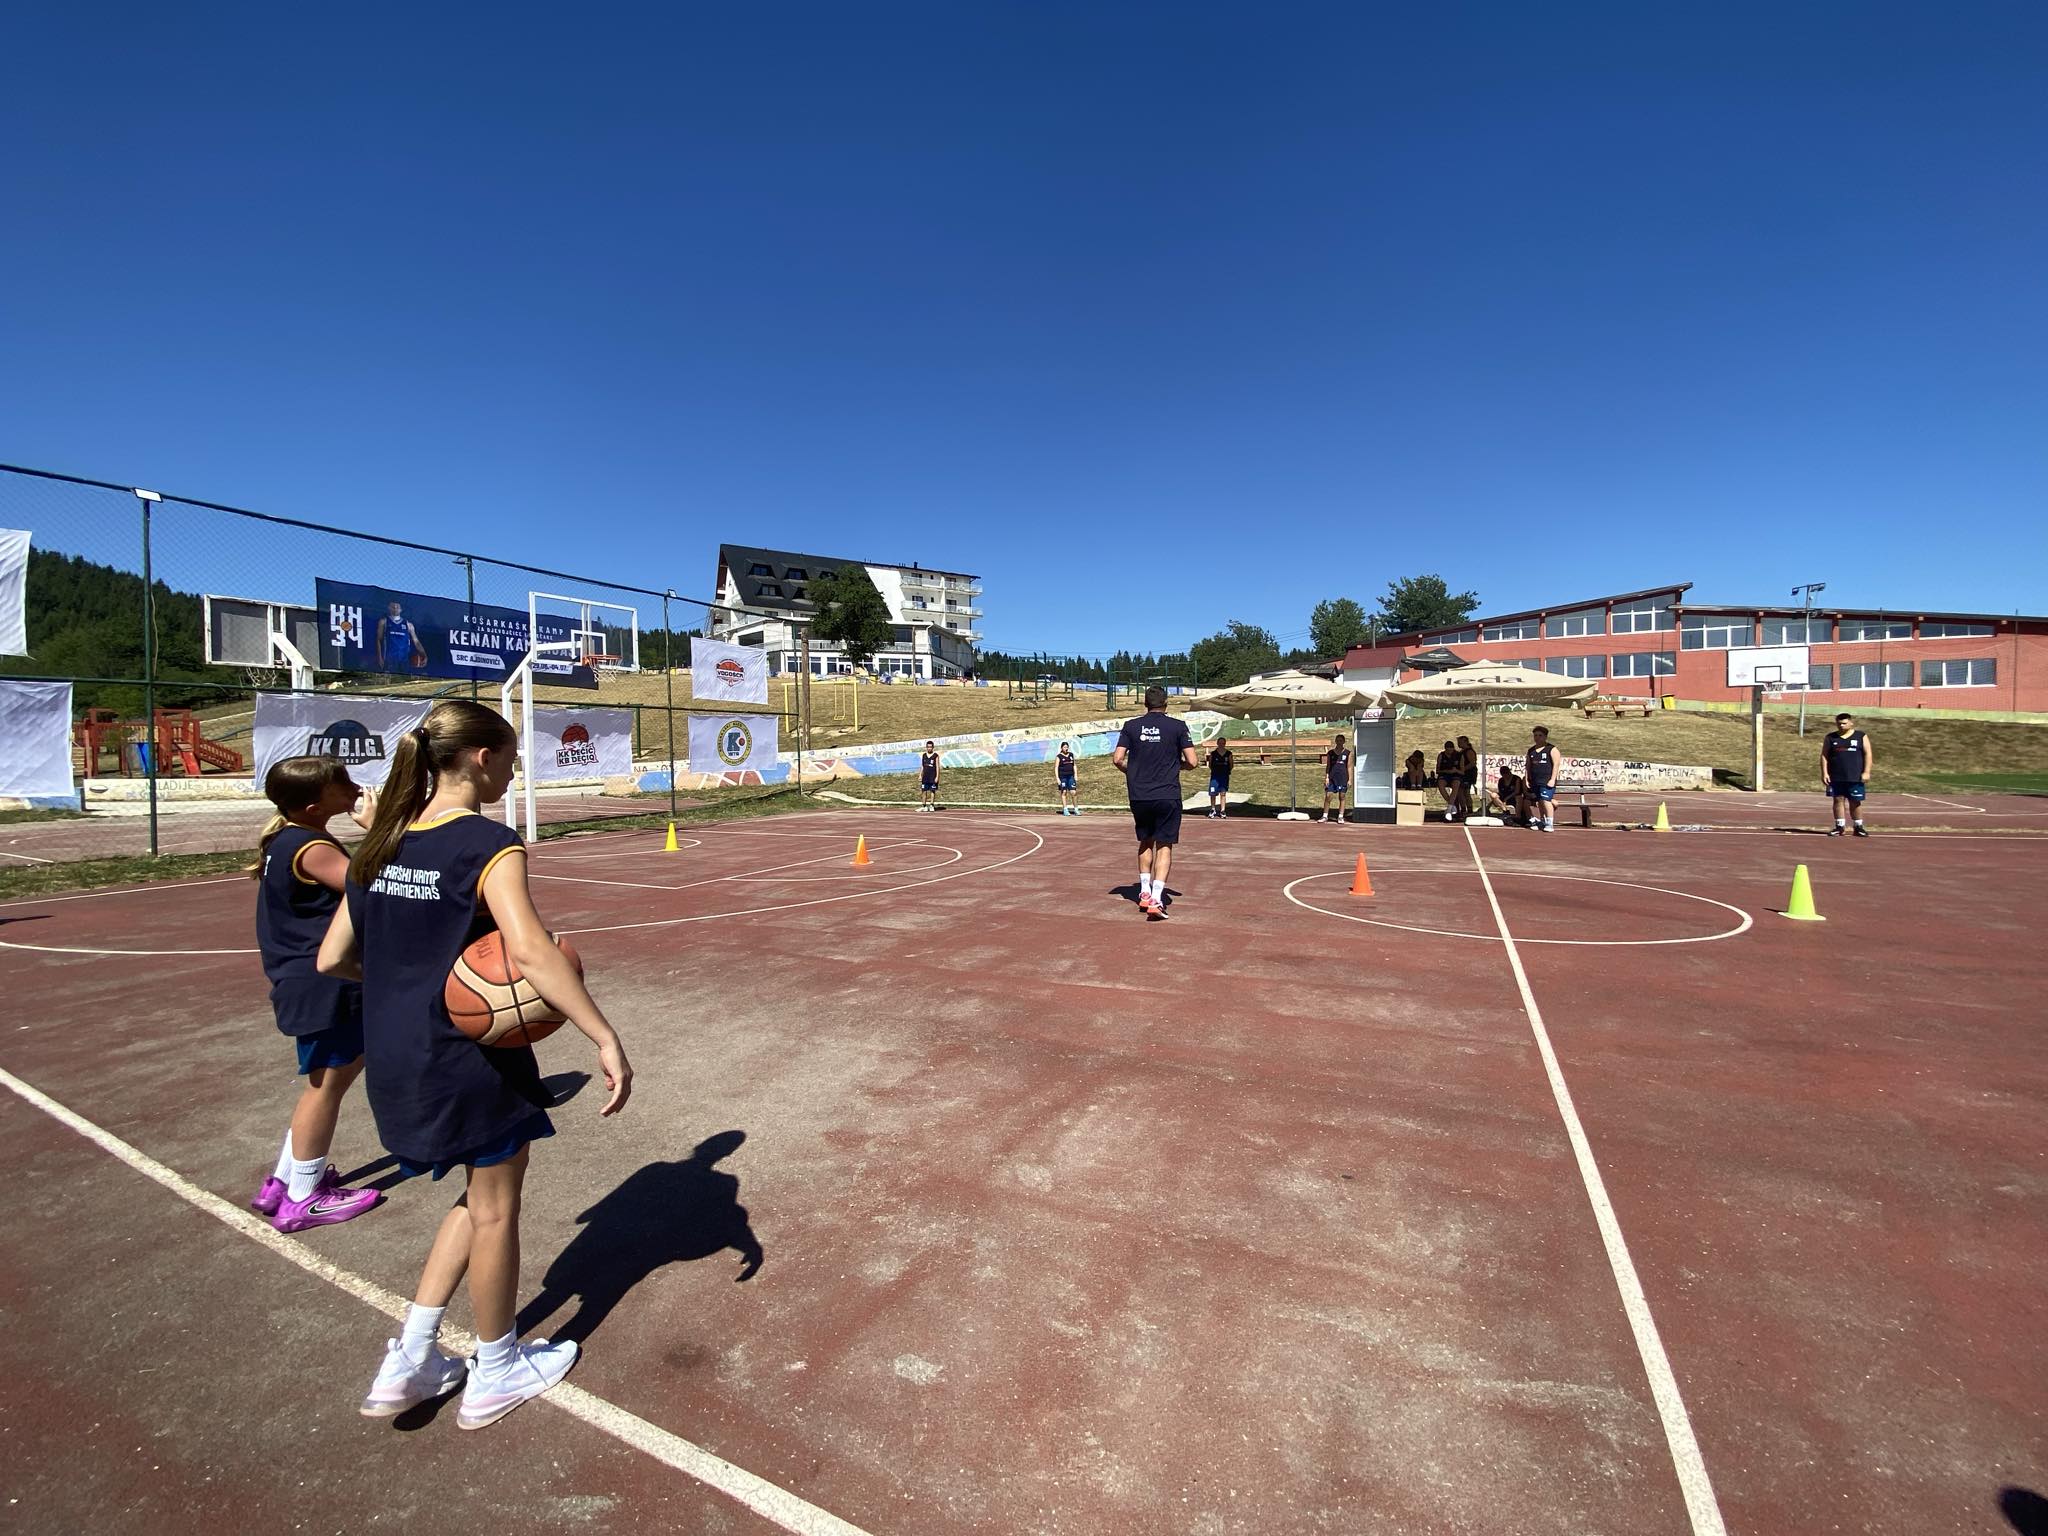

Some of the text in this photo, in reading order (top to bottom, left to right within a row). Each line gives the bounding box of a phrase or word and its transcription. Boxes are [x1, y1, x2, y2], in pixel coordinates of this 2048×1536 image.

[463, 615, 564, 635] KOŠARKAŠK KAMP
[449, 629, 501, 649] KENAN
[456, 654, 469, 663] SRC
[1446, 675, 1525, 686] leda
[1243, 684, 1304, 693] leda
[1471, 688, 1518, 698] SPRING
[1523, 688, 1569, 696] WATER
[1141, 725, 1160, 735] leda
[310, 737, 382, 757] KK B.I.G.
[558, 750, 569, 758] KK
[558, 757, 570, 765] KB
[1658, 768, 1696, 777] MEDINA
